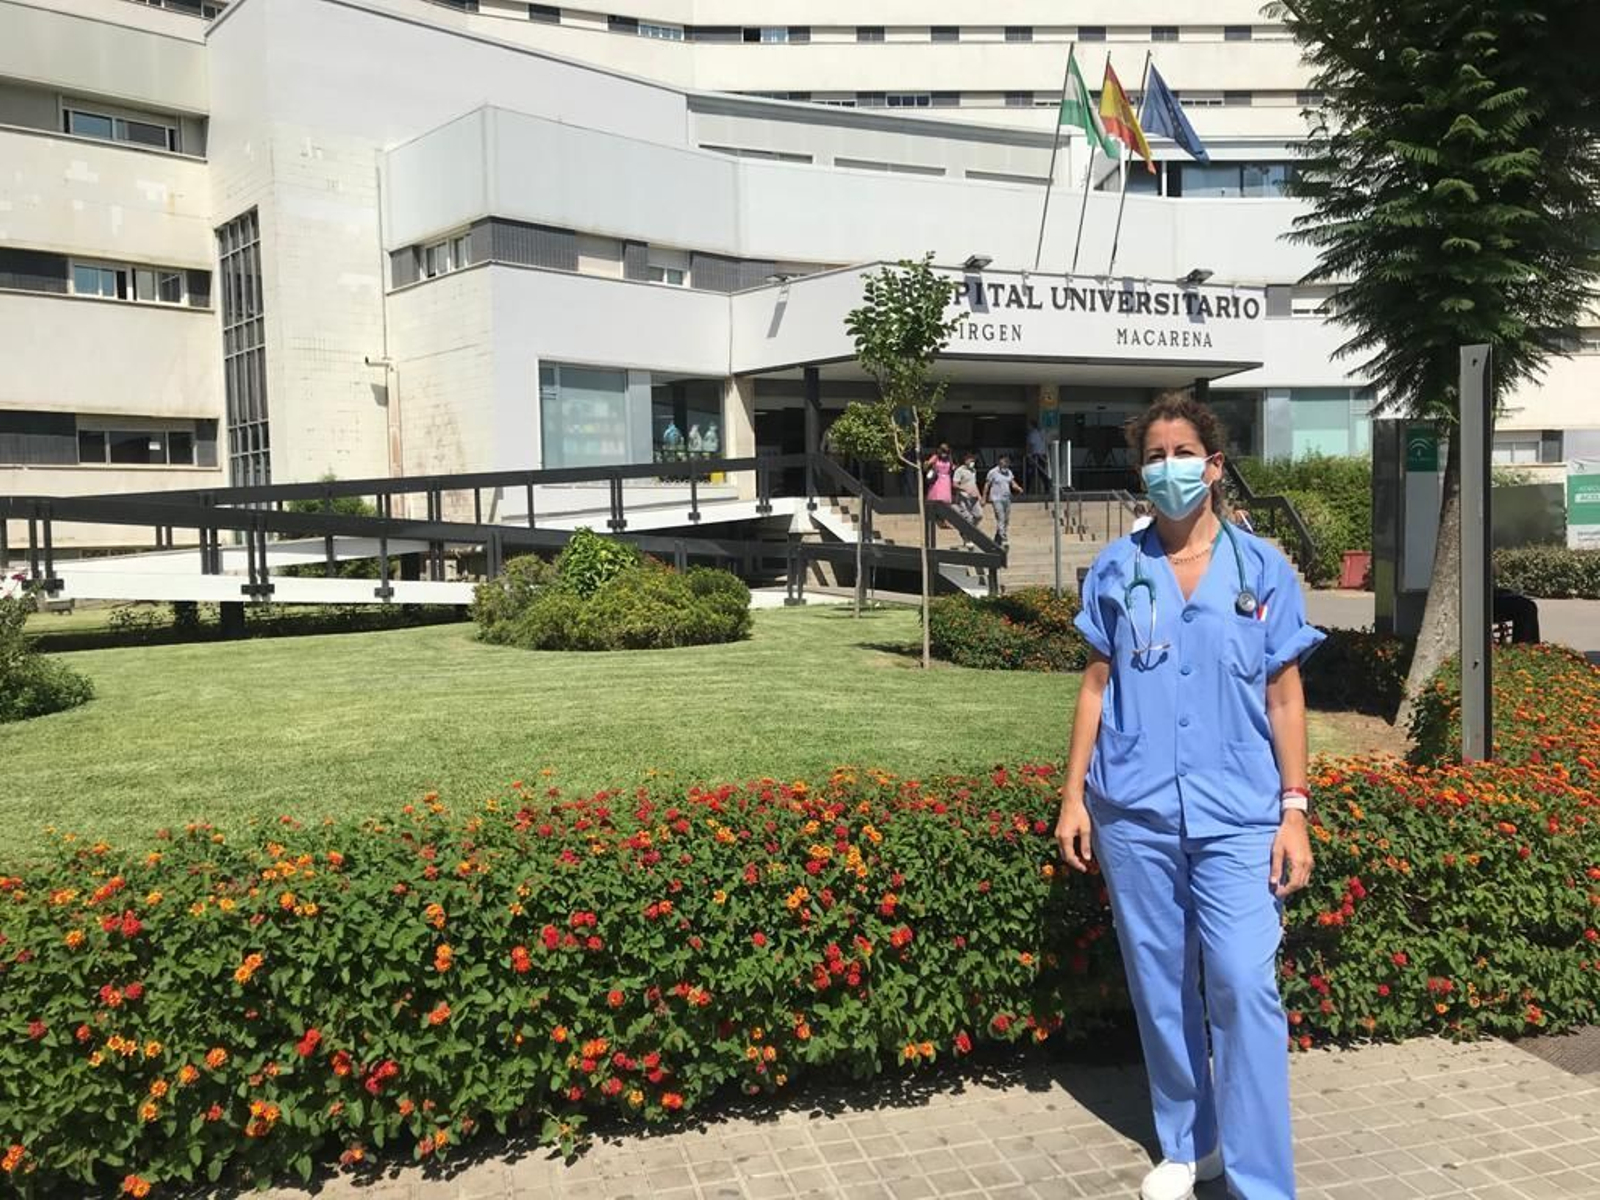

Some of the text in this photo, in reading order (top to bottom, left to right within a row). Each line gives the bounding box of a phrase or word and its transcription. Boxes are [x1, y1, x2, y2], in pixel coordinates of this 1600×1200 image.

[898, 278, 1260, 320] PITAL UNIVERSITARIO
[942, 321, 1213, 348] IRGEN MACARENA
